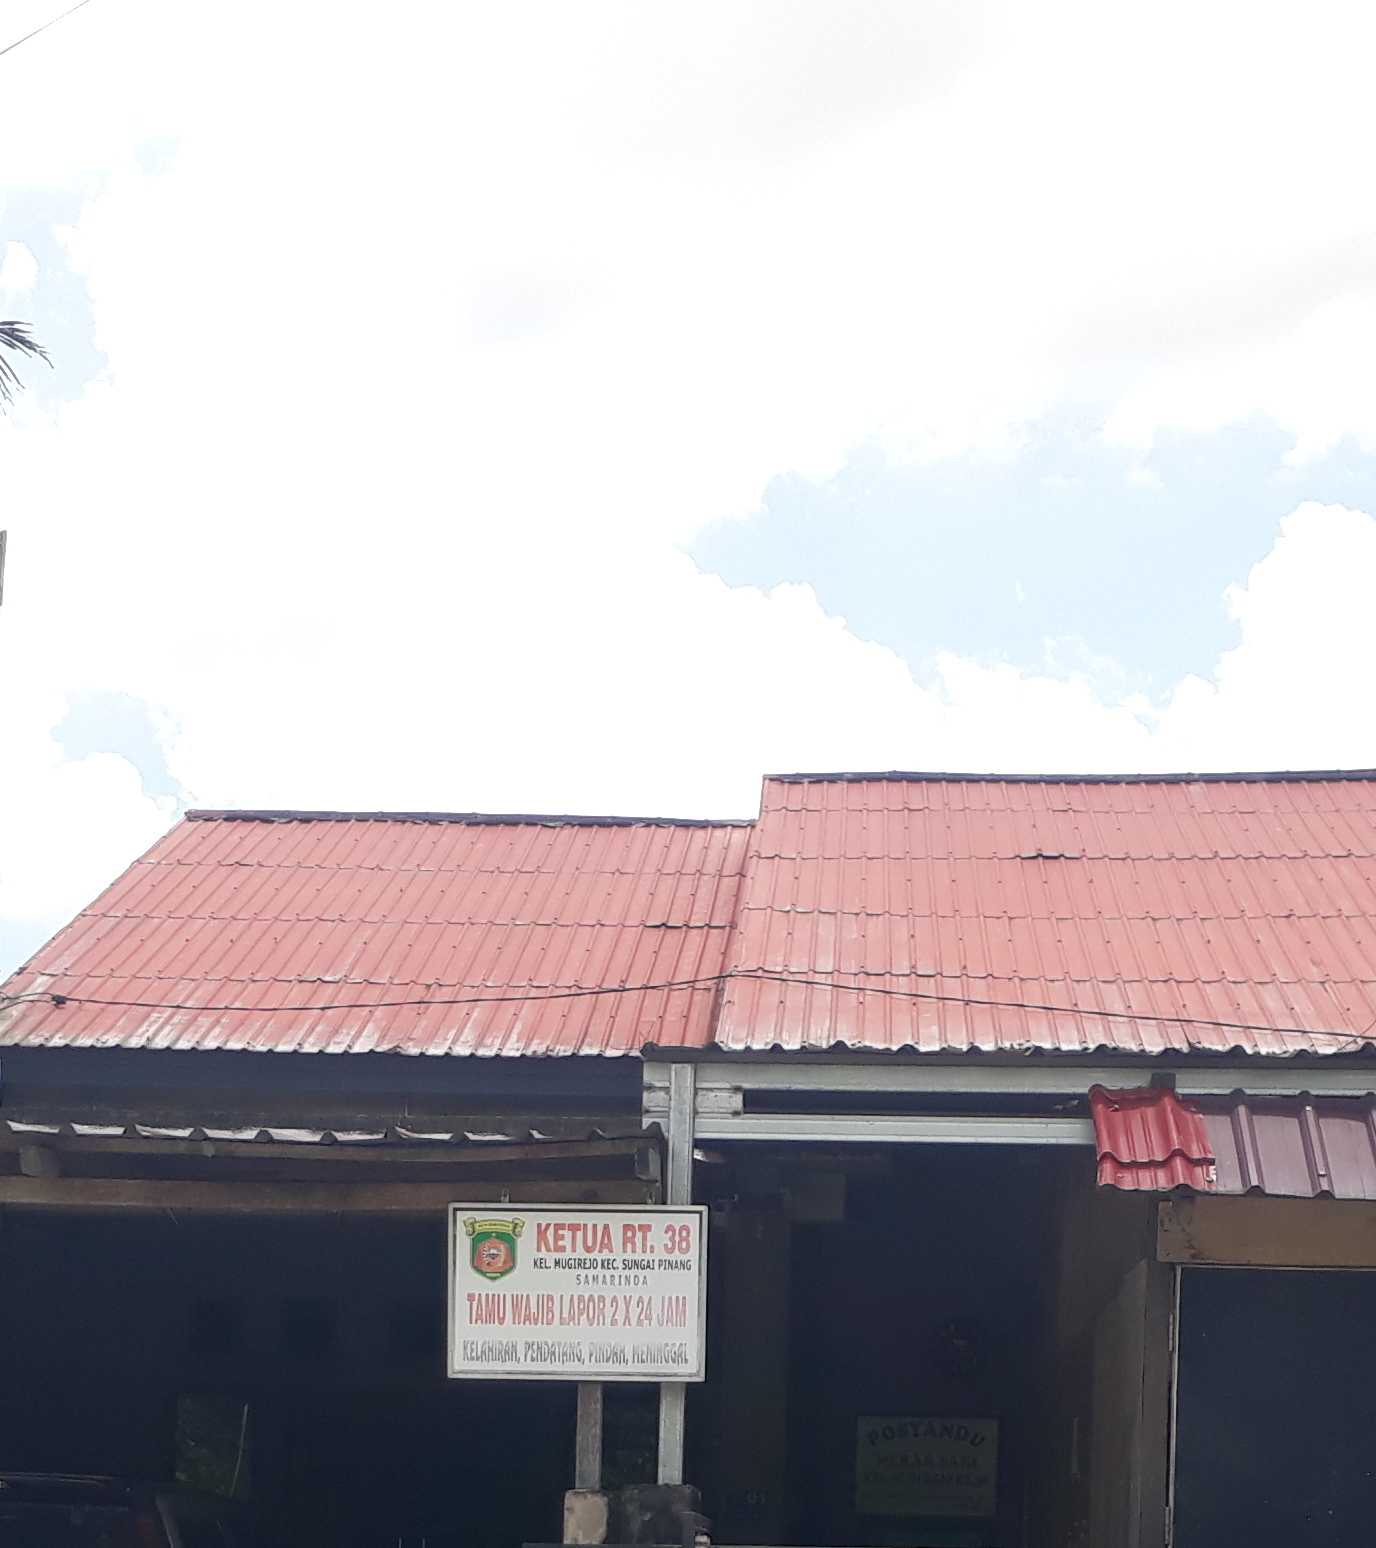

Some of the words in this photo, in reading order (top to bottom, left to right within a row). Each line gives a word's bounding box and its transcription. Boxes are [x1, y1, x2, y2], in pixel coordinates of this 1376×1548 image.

[536, 1222, 614, 1254] KETUA
[621, 1223, 656, 1254] RT.
[663, 1224, 692, 1255] 38
[533, 1257, 552, 1270] KEL.
[554, 1257, 599, 1271] MUGIREJO
[600, 1258, 619, 1271] KEC.
[621, 1258, 656, 1272] SUNGAI
[657, 1258, 692, 1272] PINANG
[575, 1273, 649, 1287] SAMARINDA
[467, 1292, 507, 1326] TAMU
[510, 1293, 555, 1327] WAJIB
[559, 1293, 606, 1327] LAPOR
[610, 1294, 619, 1328] 2
[622, 1294, 633, 1328] X
[635, 1294, 654, 1328] 24
[656, 1295, 687, 1328] JAM
[463, 1339, 521, 1364] KELAHIRAN,
[524, 1340, 586, 1366] PENDATANG,
[632, 1342, 689, 1366] MENINGGAL
[865, 1419, 987, 1448] POSYANDU
